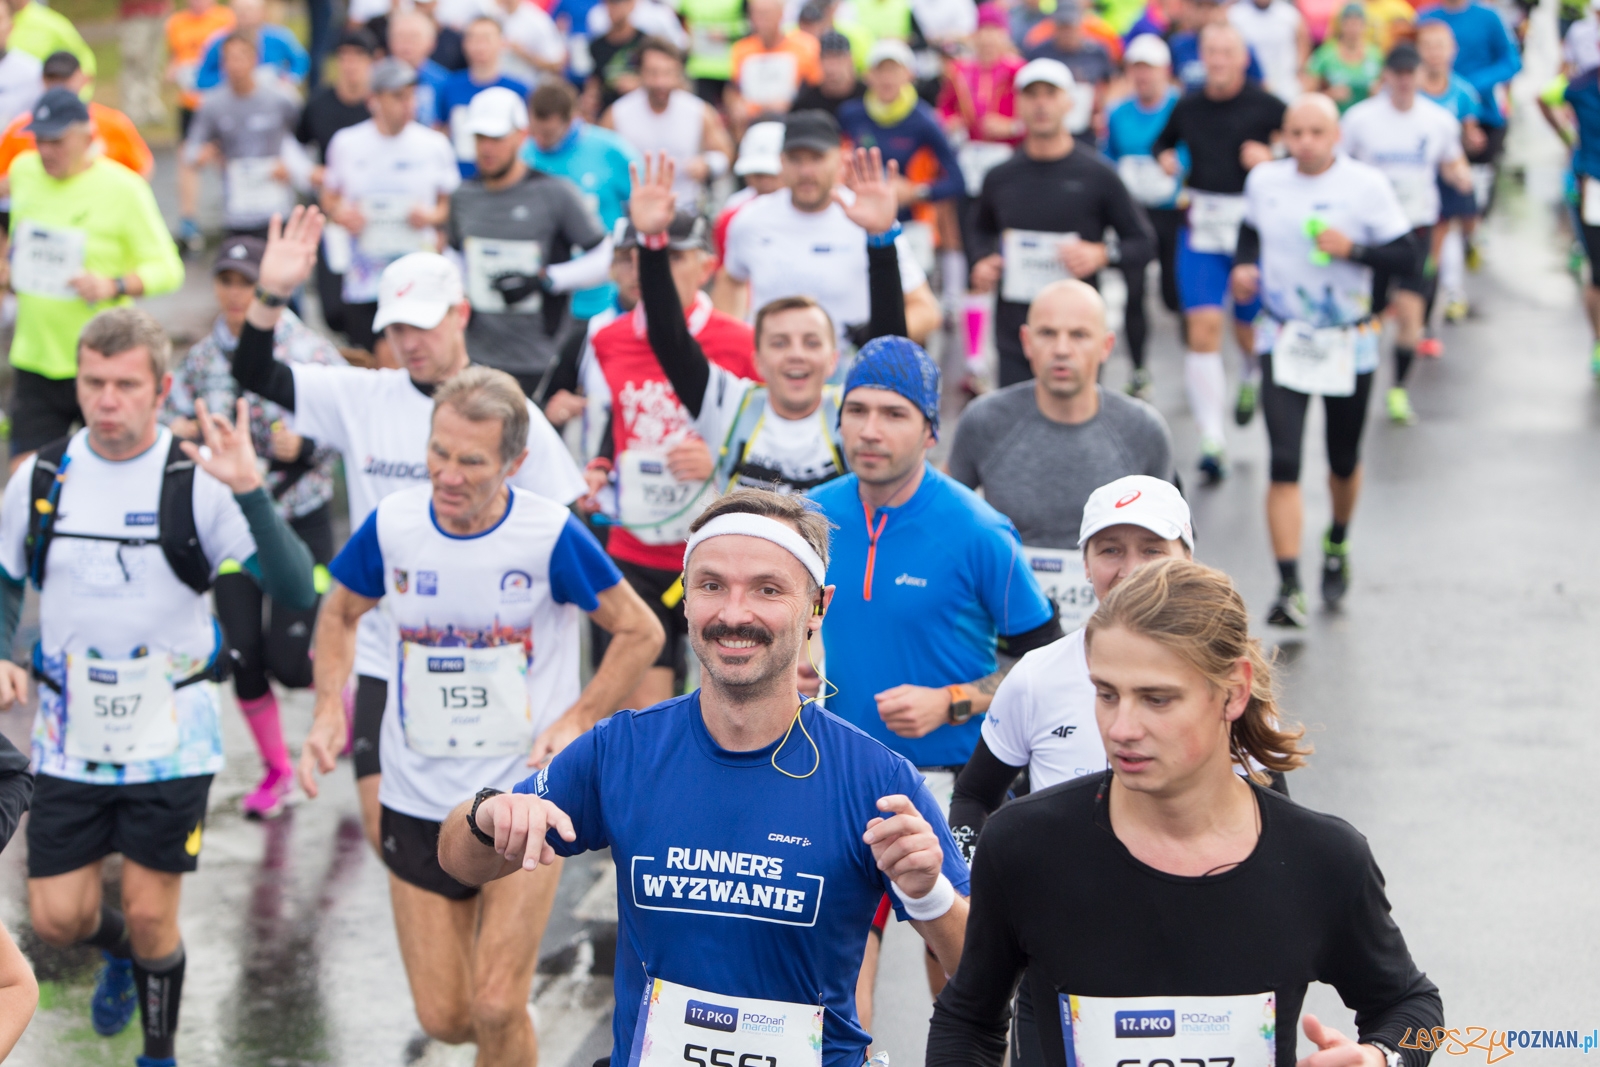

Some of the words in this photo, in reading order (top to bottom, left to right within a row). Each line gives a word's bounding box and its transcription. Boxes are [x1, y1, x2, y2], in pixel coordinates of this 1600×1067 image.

[93, 693, 142, 718] 567
[440, 686, 488, 708] 153
[1051, 725, 1077, 738] 4F
[767, 833, 803, 845] CRAFT
[666, 846, 784, 880] RUNNER'S
[642, 874, 806, 913] WYZWANIE
[741, 1021, 785, 1034] maraton
[1181, 1022, 1231, 1033] maraton
